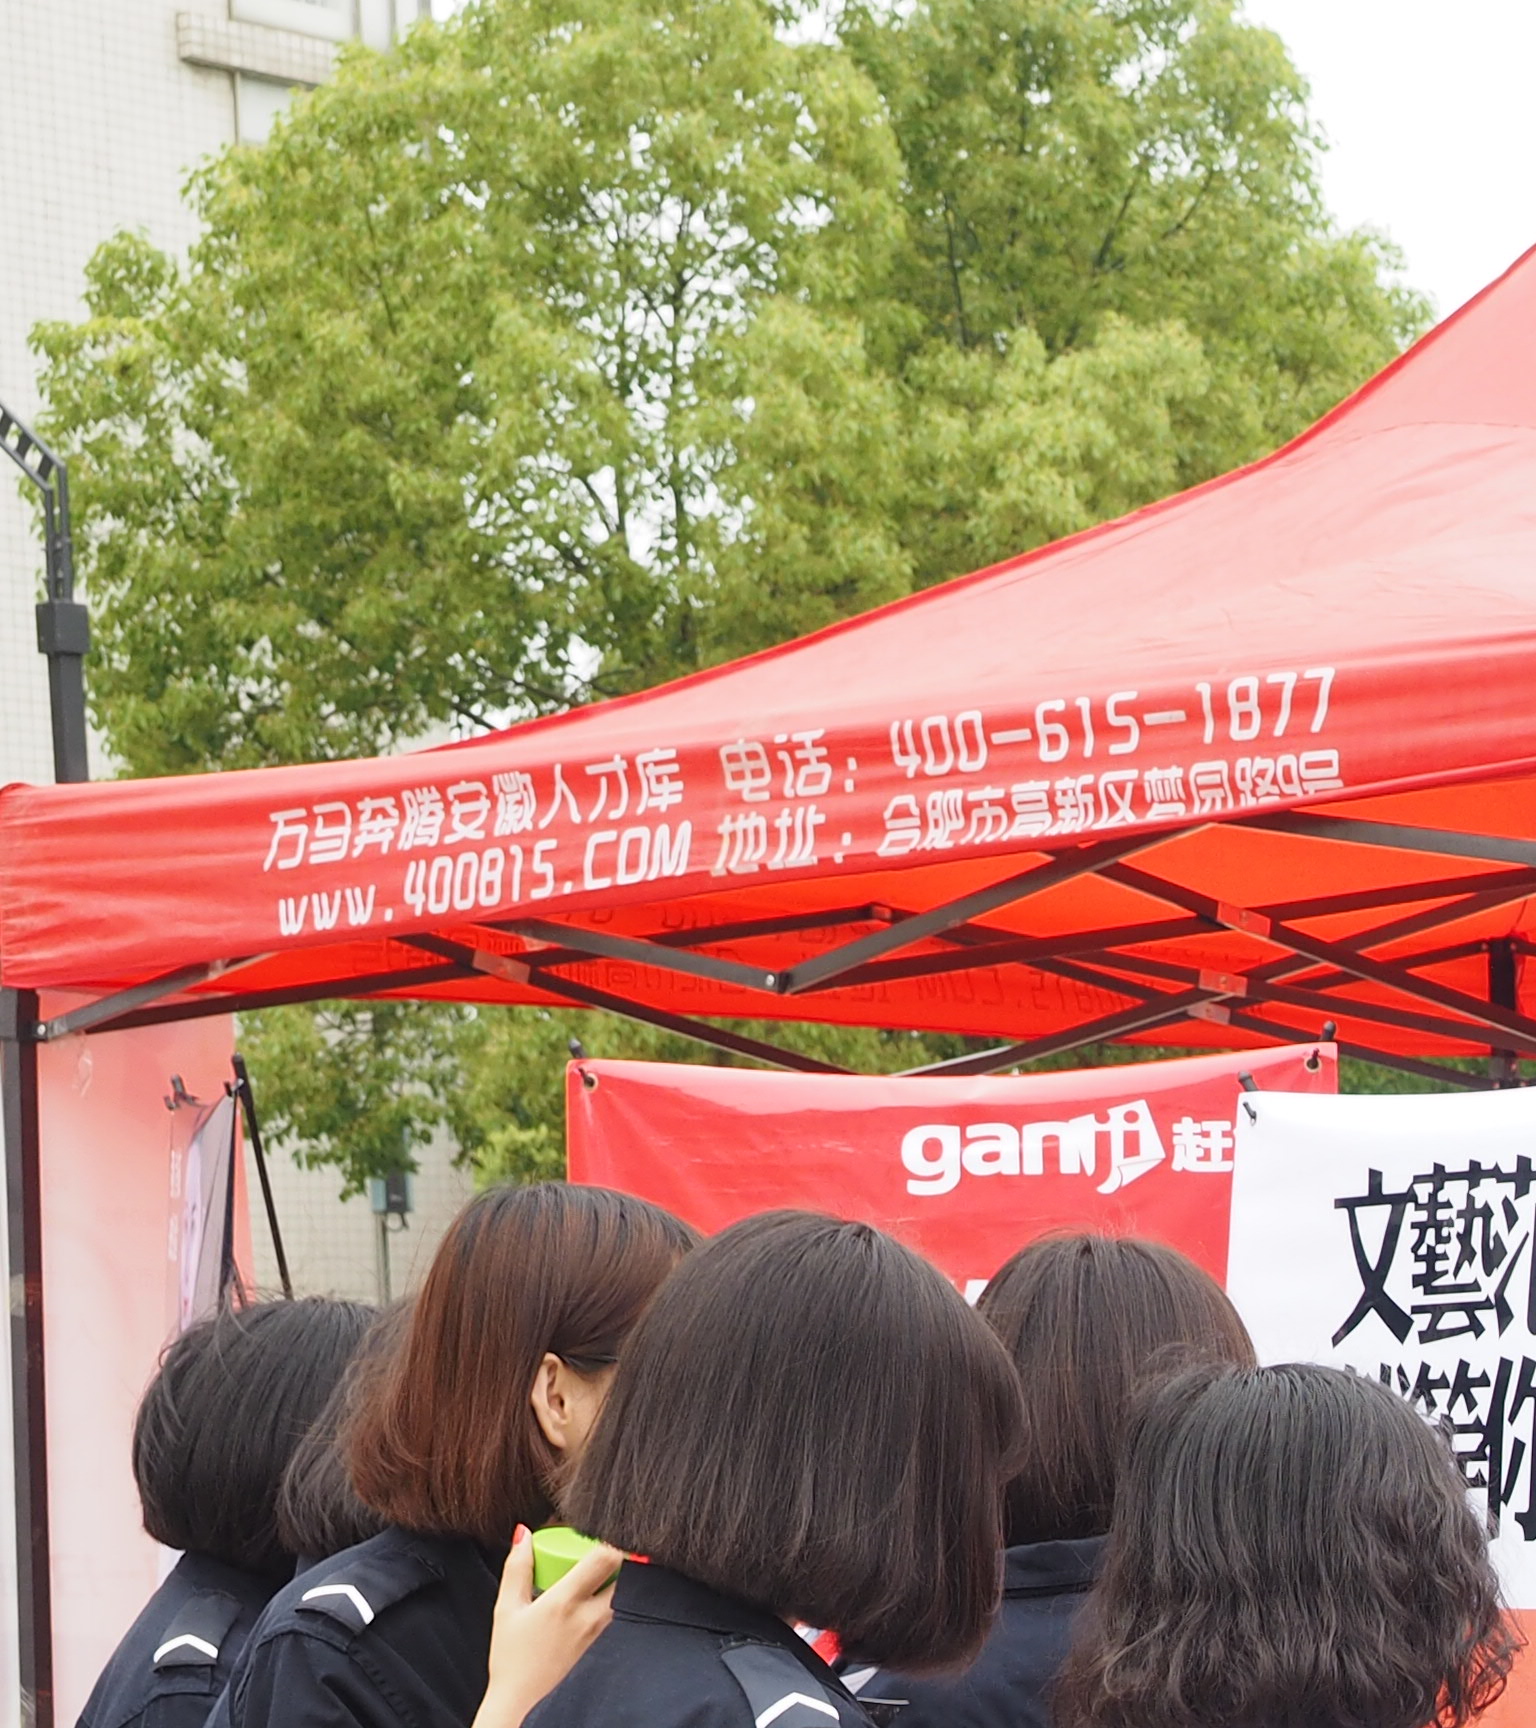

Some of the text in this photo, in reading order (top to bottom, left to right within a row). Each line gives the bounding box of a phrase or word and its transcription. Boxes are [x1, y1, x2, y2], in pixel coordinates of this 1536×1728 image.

[263, 748, 684, 872] 万马奔腾安徽人才库
[890, 667, 1335, 778] 400-615-1877
[278, 820, 692, 936] www.400815.COM
[901, 1099, 1166, 1196] ganji
